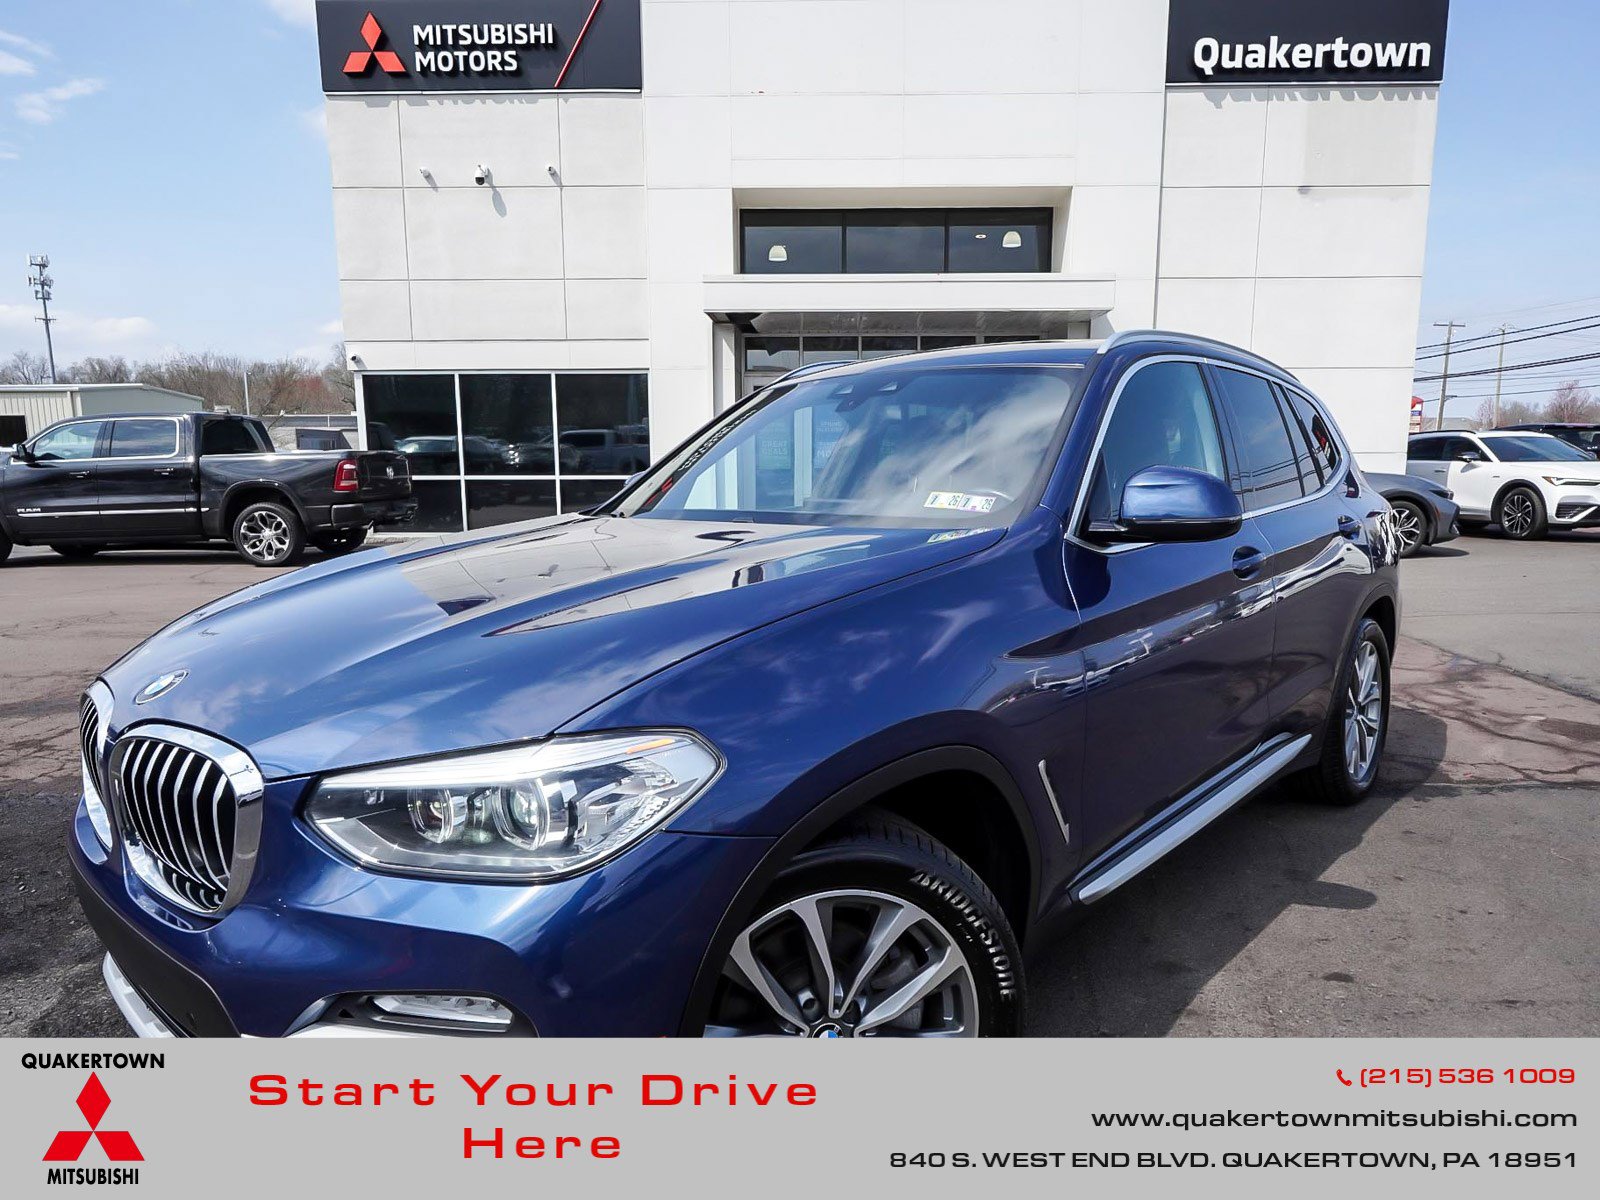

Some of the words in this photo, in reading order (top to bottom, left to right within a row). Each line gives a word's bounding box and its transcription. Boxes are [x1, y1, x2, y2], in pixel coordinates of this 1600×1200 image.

[412, 23, 554, 46] MITSUBISHI
[414, 50, 518, 72] MOTORS
[1193, 35, 1432, 76] Quakertown
